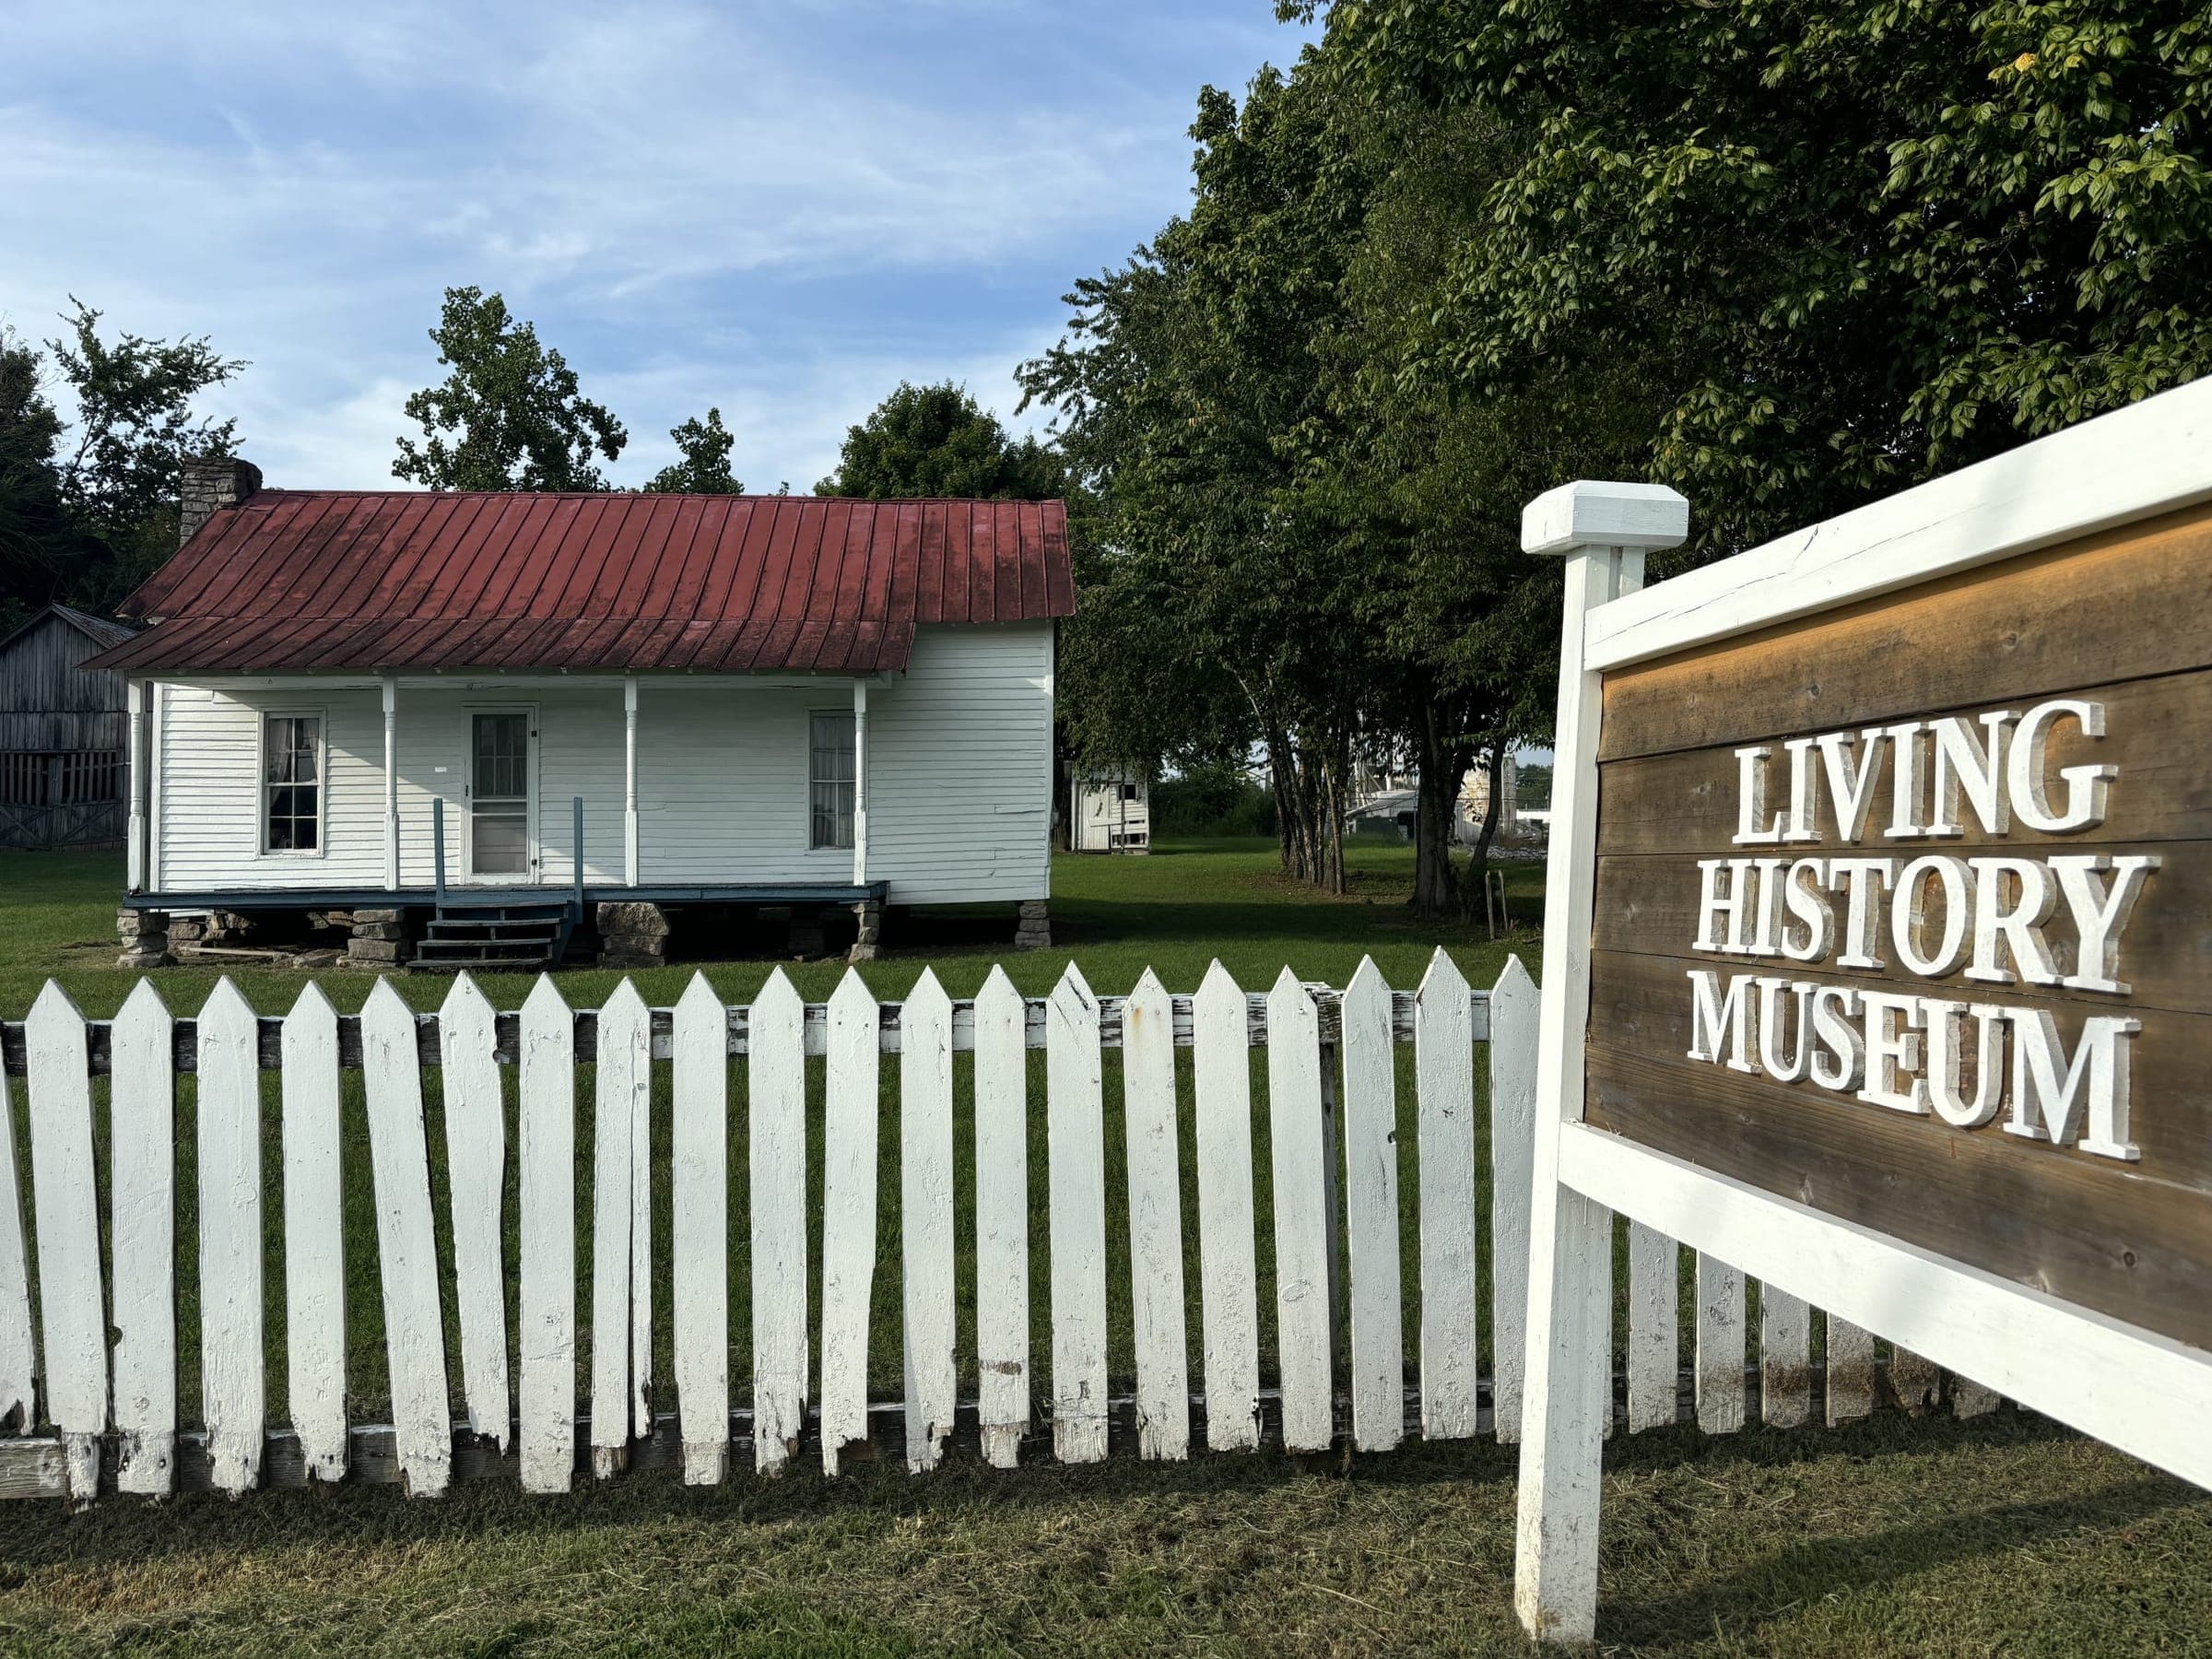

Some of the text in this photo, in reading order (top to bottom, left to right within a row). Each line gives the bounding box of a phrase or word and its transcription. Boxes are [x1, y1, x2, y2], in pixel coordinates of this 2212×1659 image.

[1733, 700, 2118, 844] LIVING
[1692, 854, 2162, 994] HISTORY
[1687, 971, 2142, 1160] MUSEUM
